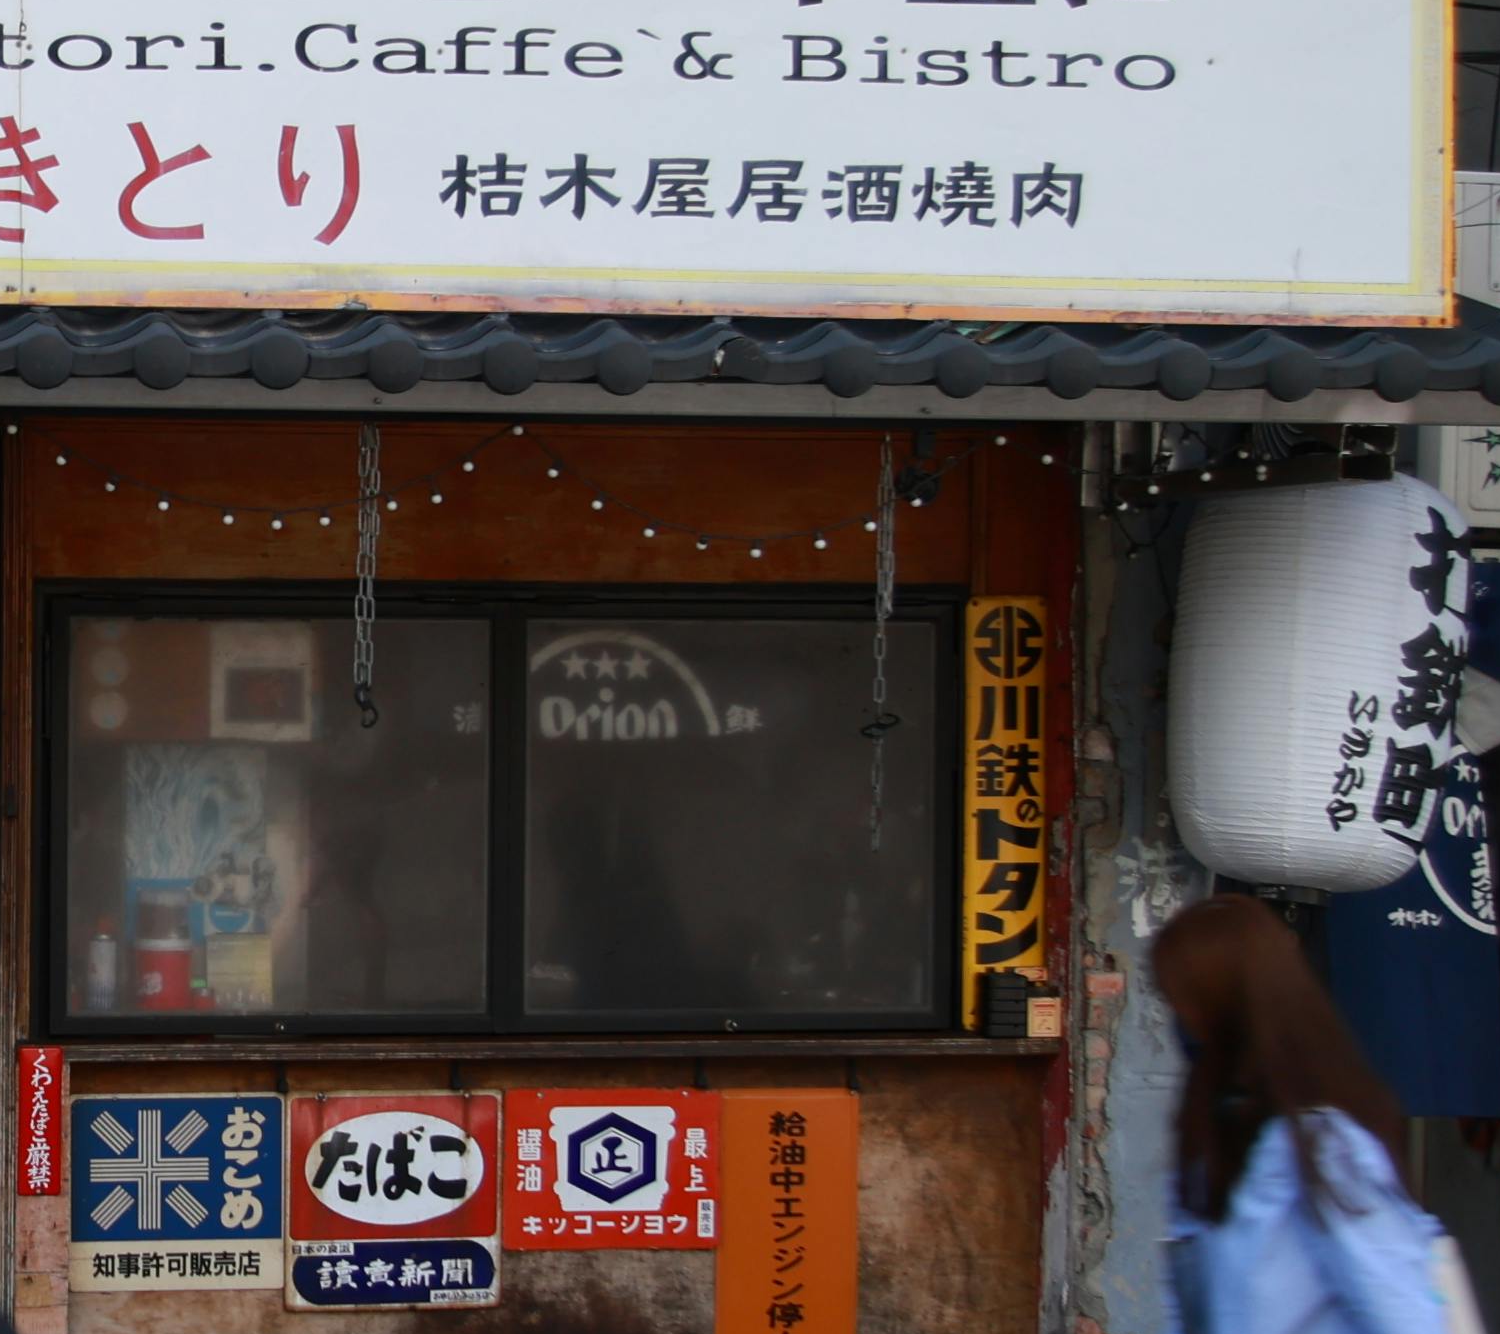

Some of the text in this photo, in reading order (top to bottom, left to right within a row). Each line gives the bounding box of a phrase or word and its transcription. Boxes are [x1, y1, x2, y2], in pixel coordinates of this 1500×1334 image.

[673, 31, 735, 80] &
[781, 33, 1177, 92] Bistro
[438, 151, 1085, 229] 桔木屋居酒燒肉
[539, 686, 680, 742] Orion
[25, 1050, 53, 1190] くわえたばこ厳禁
[219, 1105, 267, 1231] おこめ
[311, 1125, 468, 1203] たばこ
[683, 1127, 709, 1192] 最上
[91, 1251, 262, 1279] 知事許可販売店
